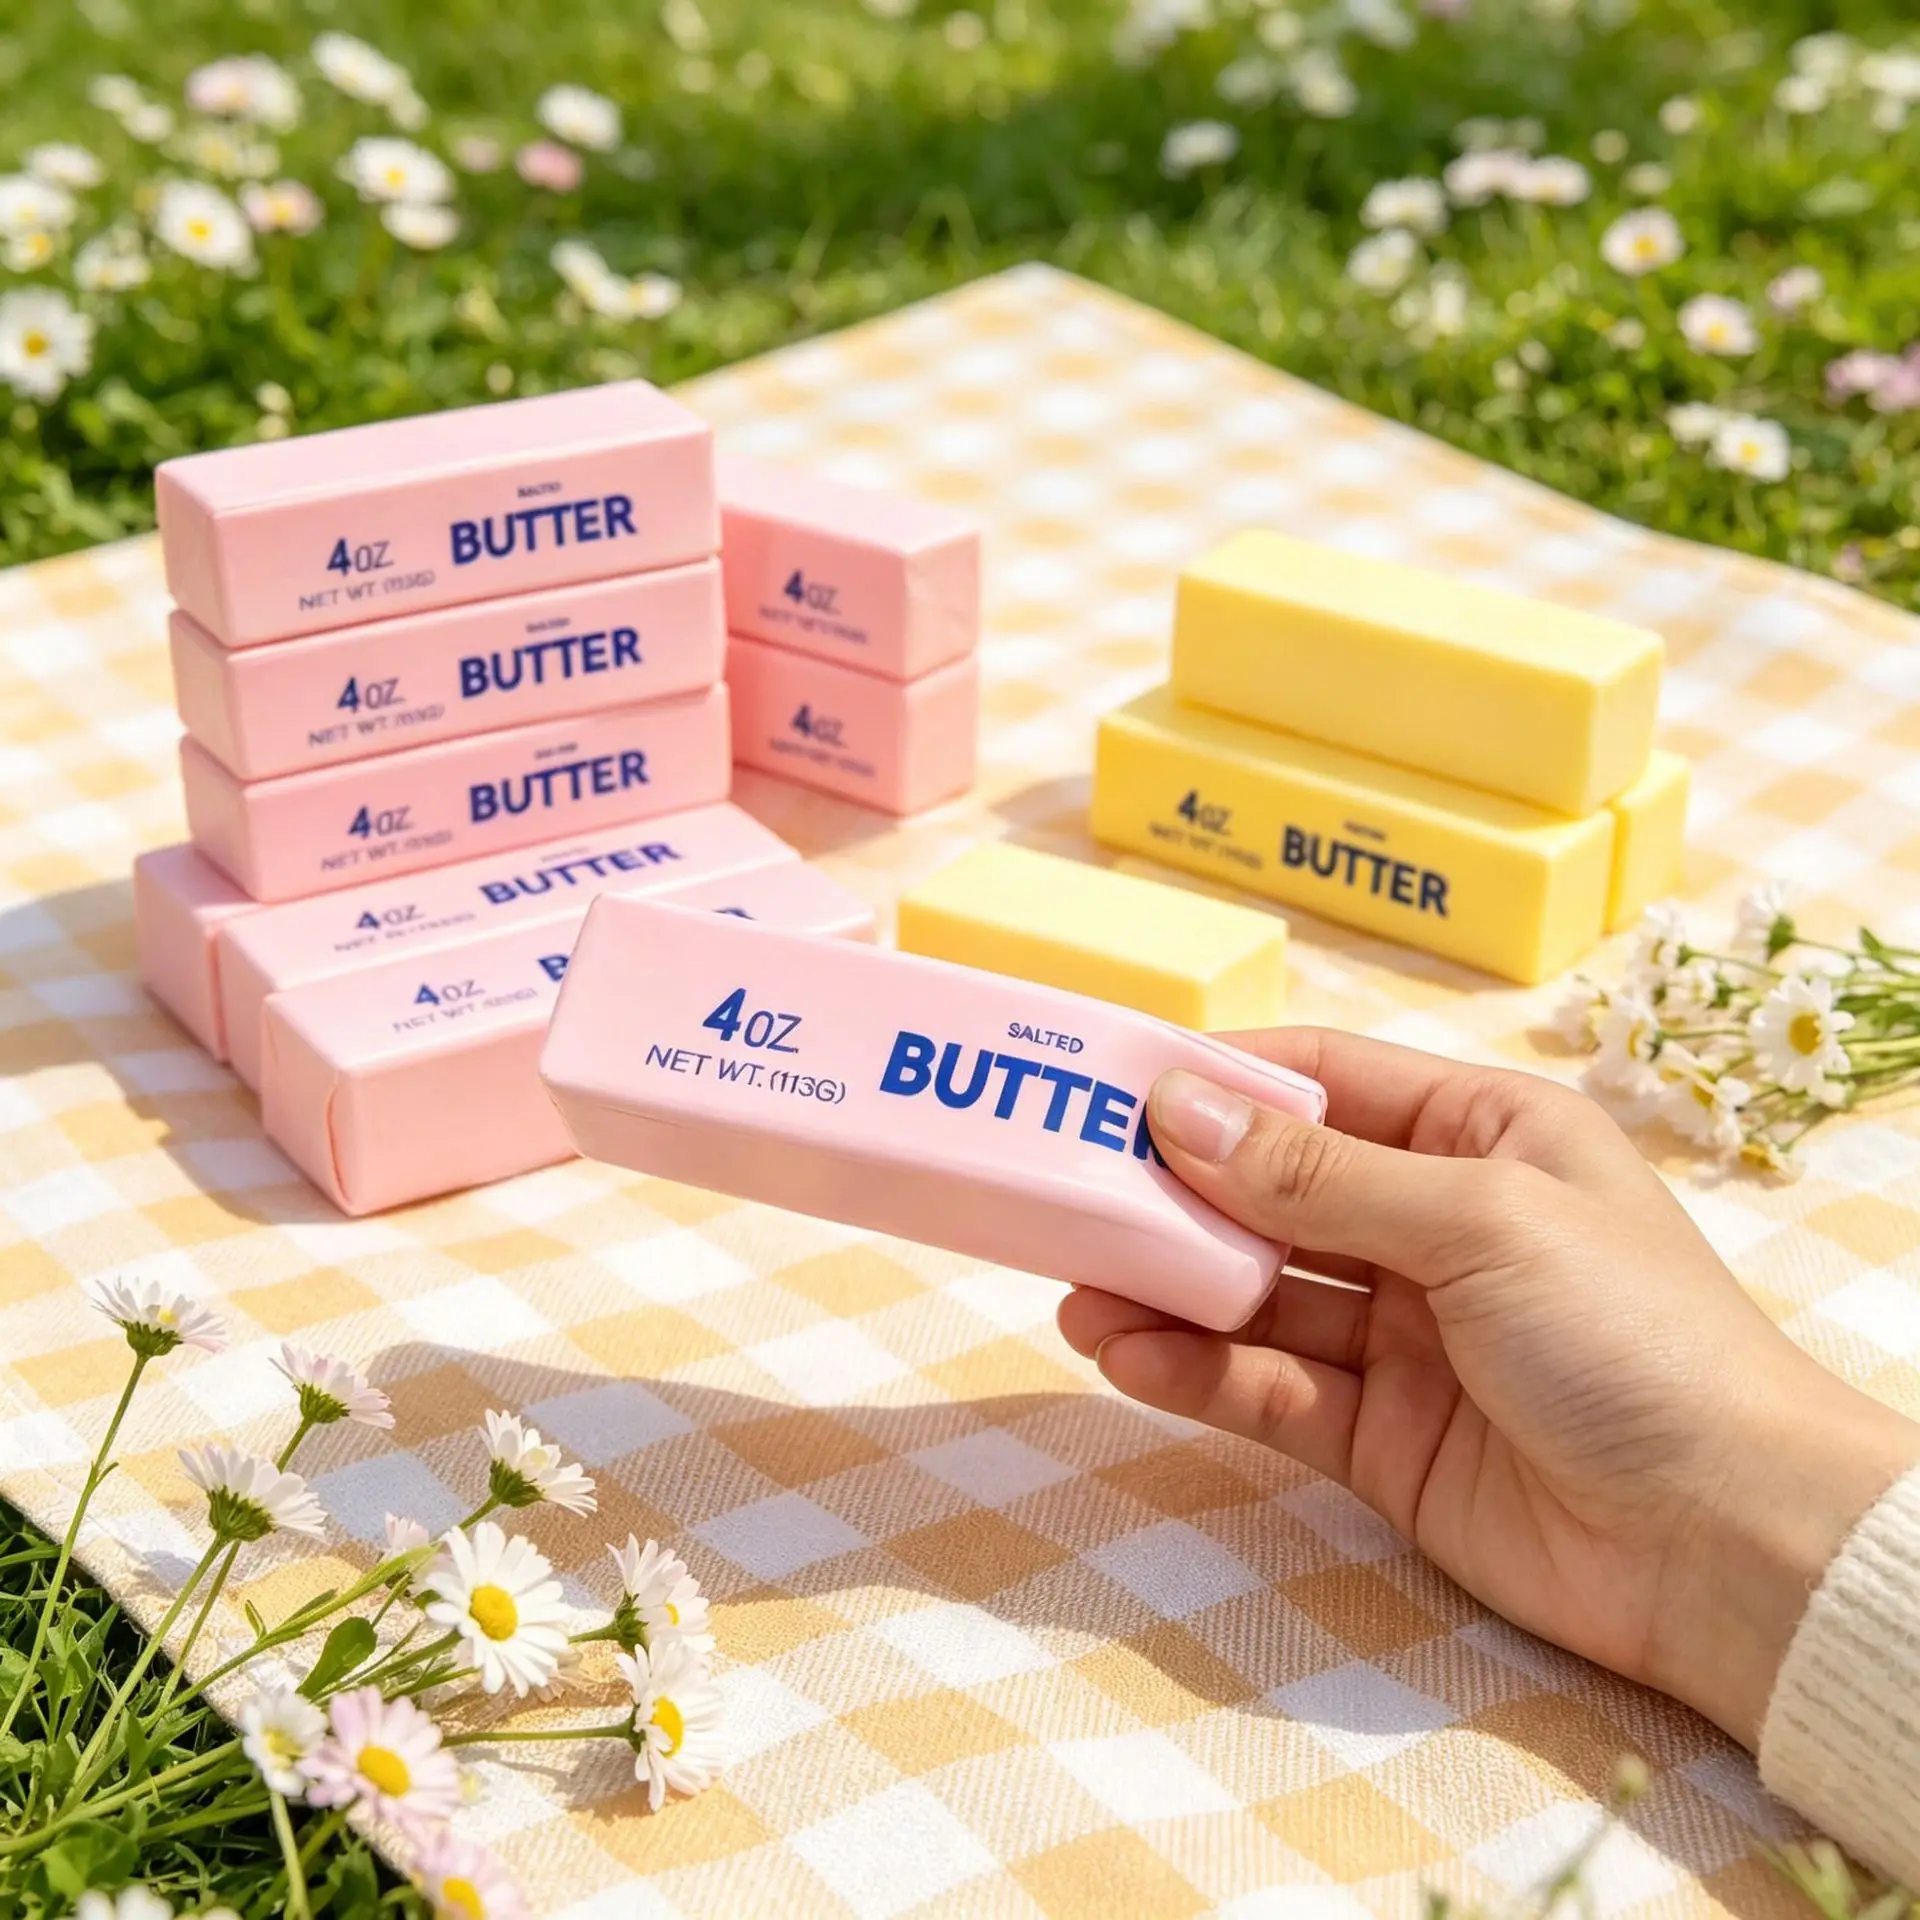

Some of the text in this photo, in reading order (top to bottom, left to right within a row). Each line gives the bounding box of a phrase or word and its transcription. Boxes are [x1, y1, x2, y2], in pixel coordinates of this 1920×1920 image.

[451, 495, 635, 564] BUTTER
[459, 626, 643, 699] BUTTER
[469, 749, 650, 823] BUTTER
[479, 842, 682, 904] BUTTER
[1281, 825, 1448, 917] BUTTER
[1007, 1021, 1085, 1055] SALTED
[645, 1044, 847, 1105] NET WT. (113G)
